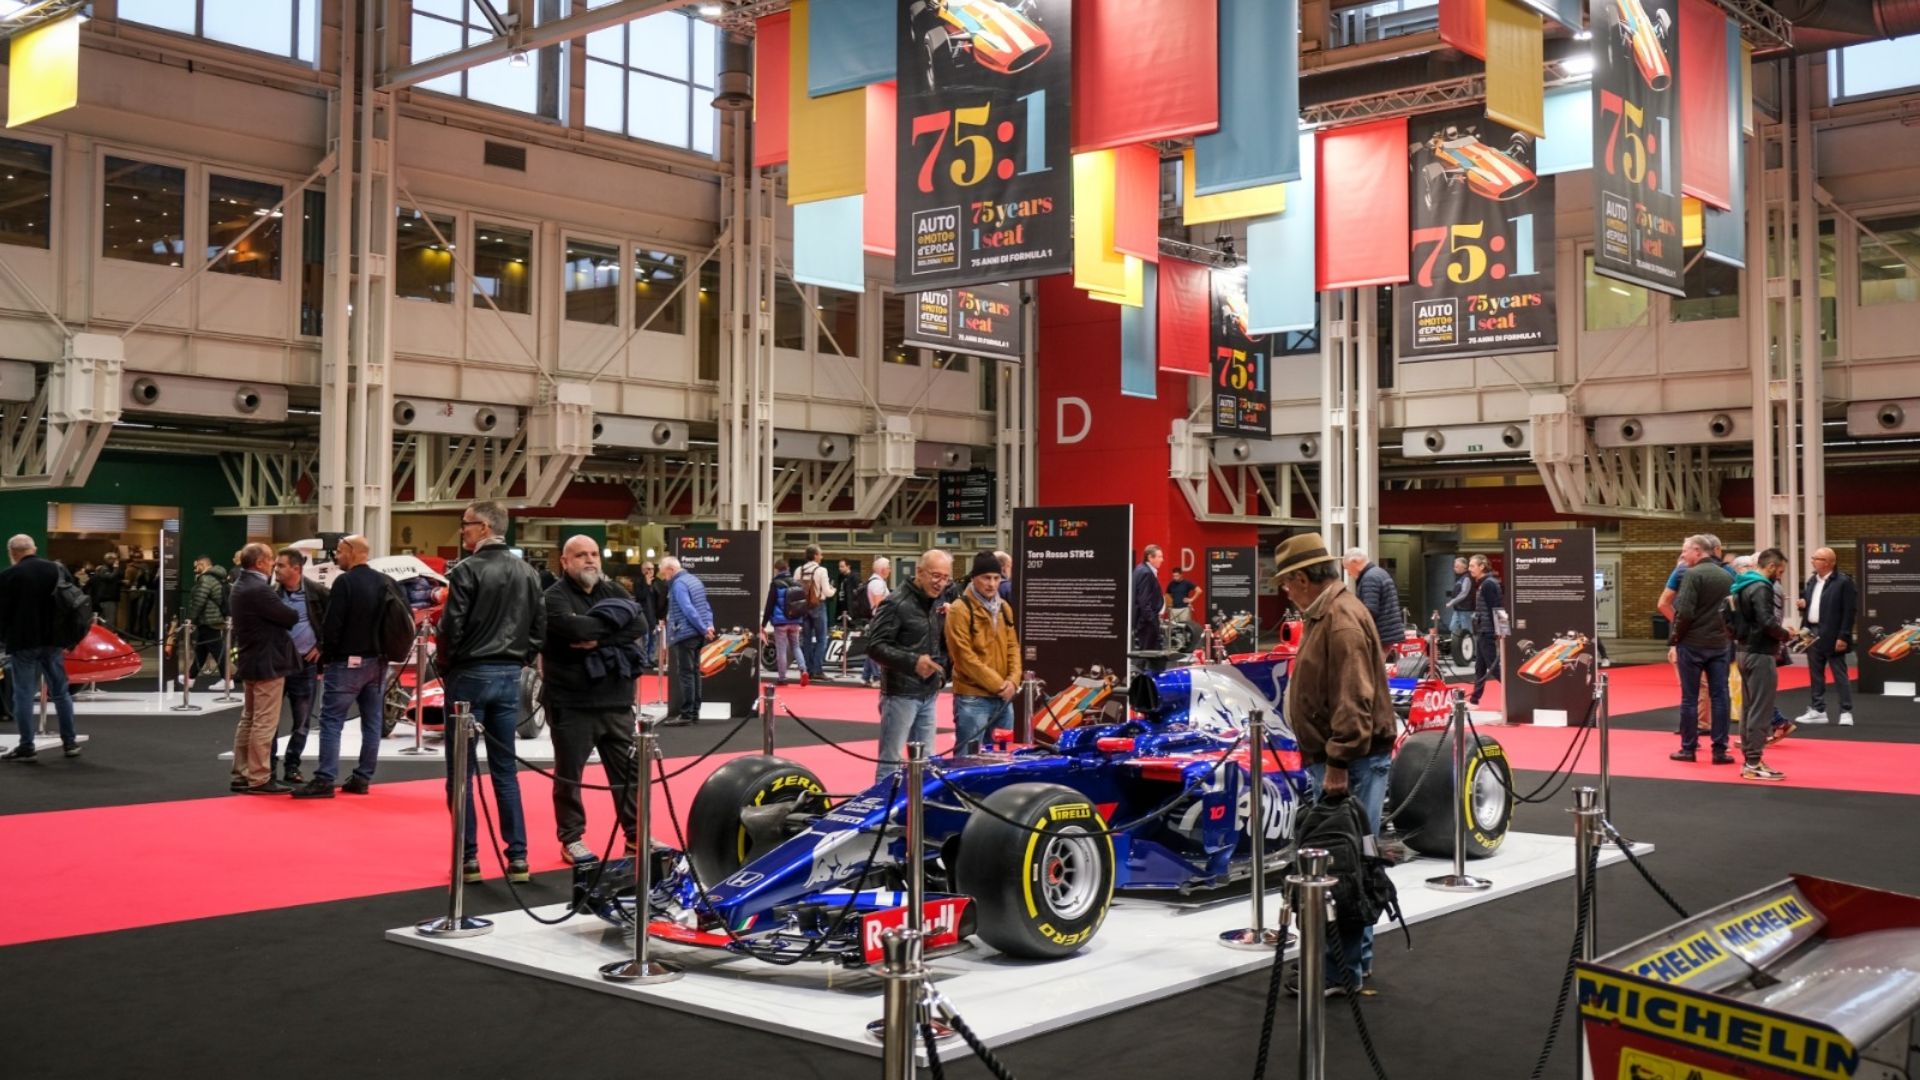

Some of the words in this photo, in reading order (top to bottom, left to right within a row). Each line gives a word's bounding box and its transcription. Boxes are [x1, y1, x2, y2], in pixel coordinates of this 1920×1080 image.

[911, 88, 1053, 193] 75:1
[1600, 88, 1674, 198] 75:1
[971, 200, 995, 225] 75
[996, 196, 1054, 228] years
[1606, 200, 1627, 221] AUTO
[918, 214, 955, 234] AUTO
[1647, 213, 1676, 237] years
[924, 232, 948, 244] MOTO
[971, 228, 981, 250] 1
[982, 223, 1025, 249] seat
[917, 242, 955, 256] d'EPOCA
[971, 259, 980, 268] 75
[981, 255, 1000, 266] ANNI
[1000, 254, 1009, 264] DI
[1009, 250, 1047, 263] FORMULA
[1411, 213, 1541, 288] 75:1
[921, 291, 948, 305] AUTO
[958, 291, 974, 310] 75
[974, 298, 1010, 316] years
[1467, 294, 1488, 312] 75
[1489, 293, 1542, 315] years
[1418, 304, 1453, 318] AUTO
[1468, 315, 1477, 331] 1
[1478, 312, 1517, 330] seat
[959, 311, 965, 328] 1
[966, 317, 993, 333] seat
[1418, 325, 1453, 335] d'EPOCA
[1424, 317, 1448, 327] MOTO
[1503, 332, 1536, 342] FORMULA
[1216, 346, 1266, 392] 75:1
[1056, 396, 1092, 444] D
[1027, 519, 1055, 537] 75:1
[1027, 550, 1044, 559] Toro
[1045, 550, 1068, 559] Rosso
[1069, 549, 1095, 559] STR12
[1027, 560, 1043, 569] 2017
[1181, 547, 1195, 572] D
[1423, 690, 1453, 712] COLA
[771, 775, 823, 795] ZERO
[1049, 803, 1091, 820] PIRELLI
[1210, 805, 1226, 820] 10
[1038, 922, 1091, 945] ZERO
[1720, 898, 1806, 949] MICHELIN
[1628, 936, 1722, 981] CHELIN
[1577, 977, 1859, 1077] MICHELIN
